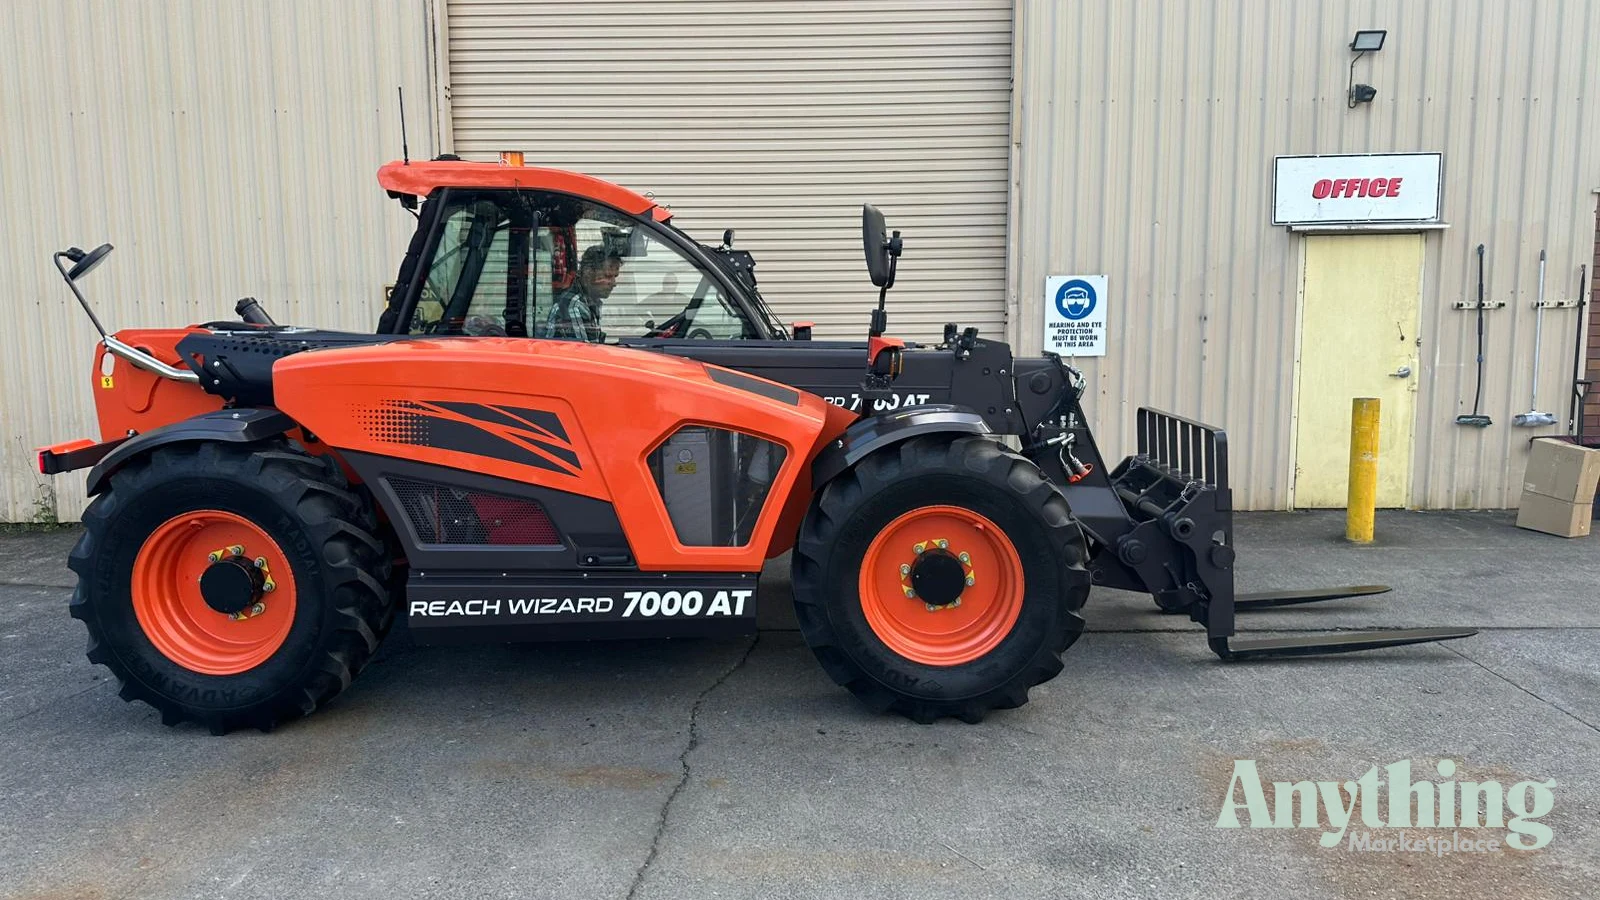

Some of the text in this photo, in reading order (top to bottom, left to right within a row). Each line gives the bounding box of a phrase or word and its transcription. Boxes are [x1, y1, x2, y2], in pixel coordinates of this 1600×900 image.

[1312, 178, 1402, 199] OFFICE
[903, 394, 930, 407] AT
[409, 590, 753, 618] REACH WIZARD 7000 AT
